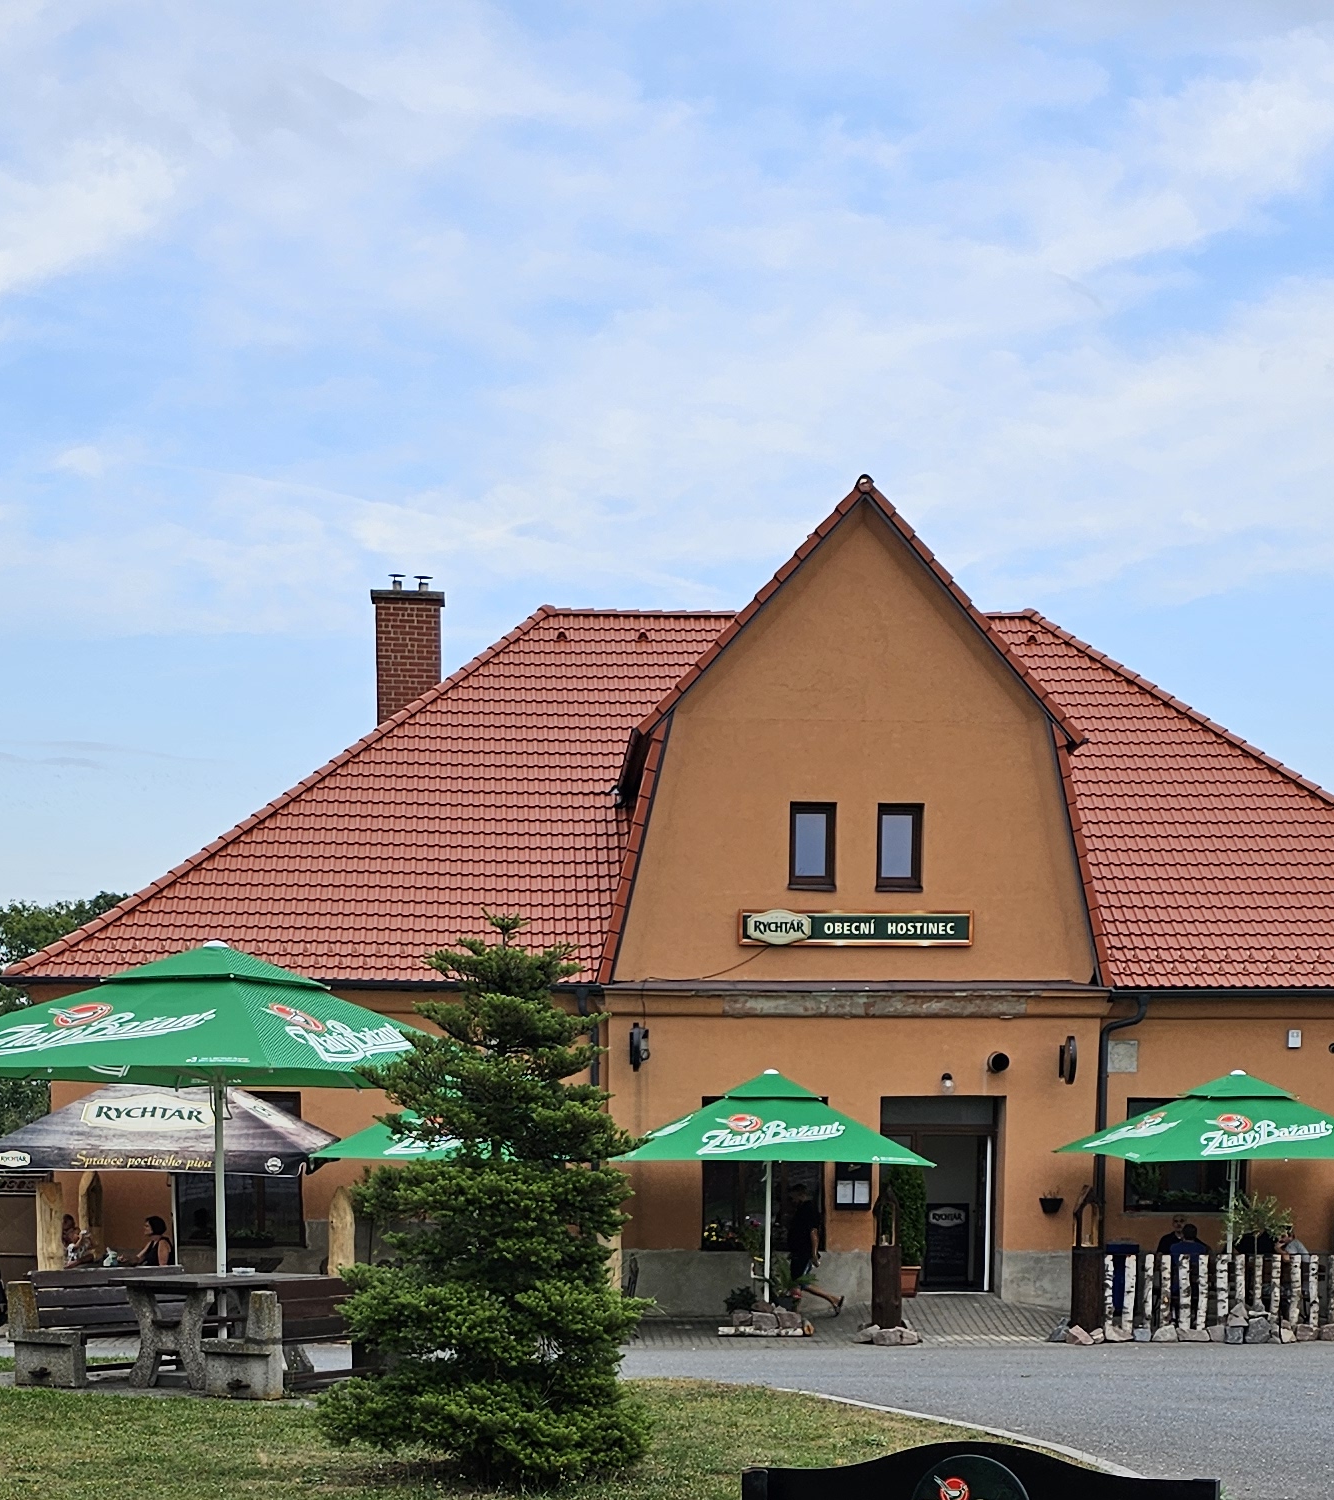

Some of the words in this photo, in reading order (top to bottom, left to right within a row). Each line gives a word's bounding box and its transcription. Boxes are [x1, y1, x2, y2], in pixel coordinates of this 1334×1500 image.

[754, 919, 807, 936] RYCHTÁŘ
[824, 919, 875, 935] OBECNÍ
[887, 922, 955, 935] HOSTINEC
[95, 1105, 208, 1124] RYCHTÁŘ
[761, 1120, 846, 1145] Bažant
[1254, 1120, 1334, 1143] Bažant
[186, 1157, 213, 1170] piva
